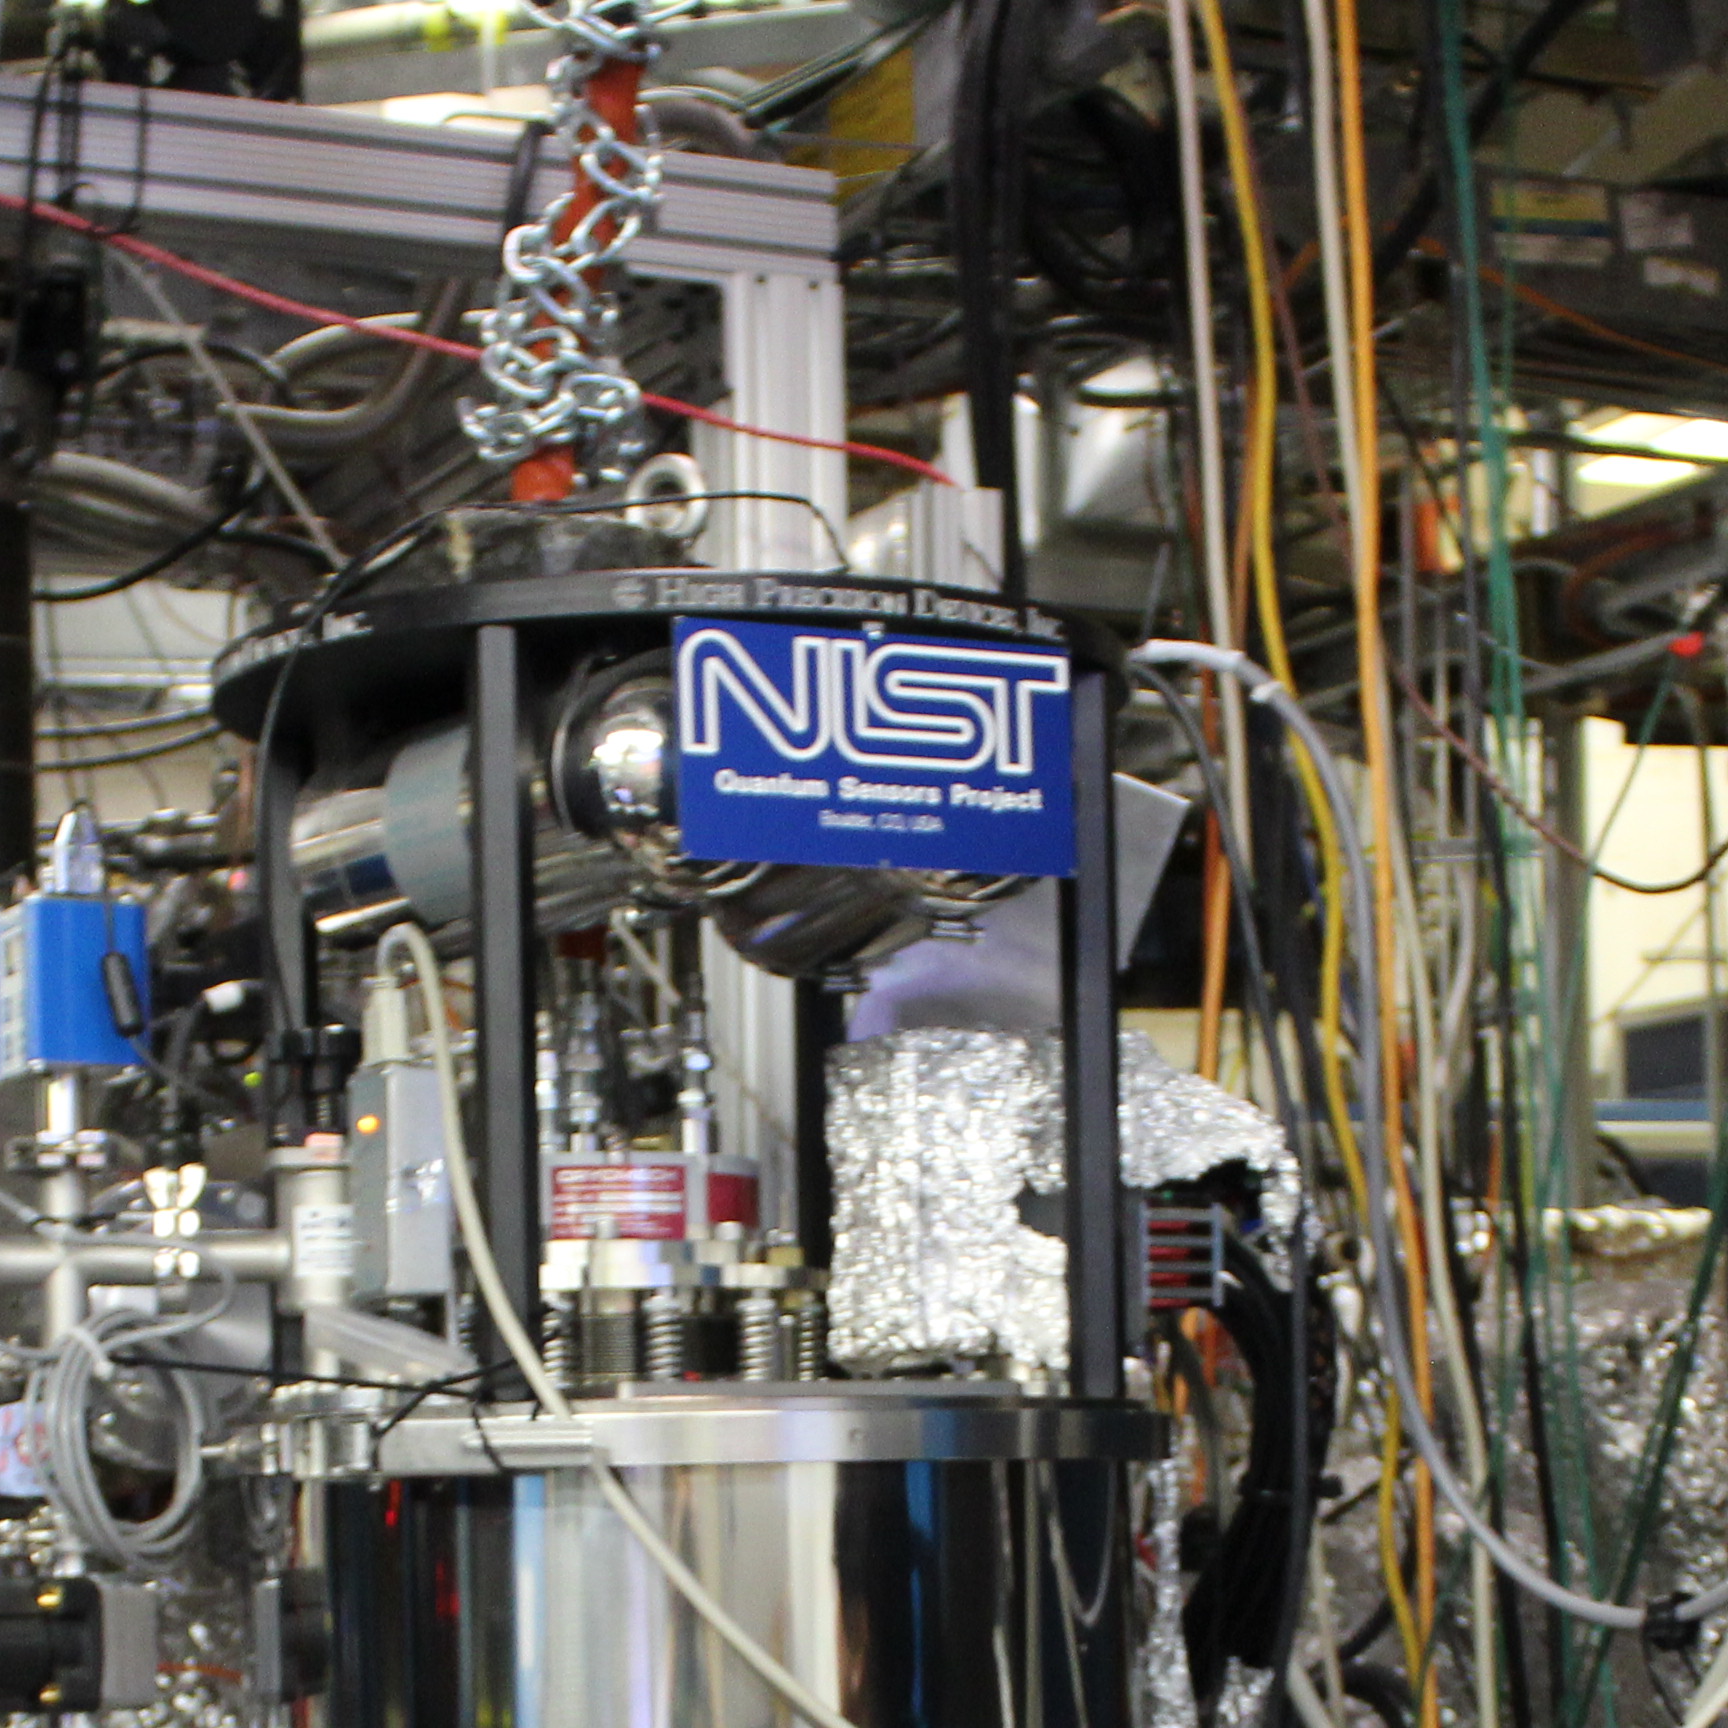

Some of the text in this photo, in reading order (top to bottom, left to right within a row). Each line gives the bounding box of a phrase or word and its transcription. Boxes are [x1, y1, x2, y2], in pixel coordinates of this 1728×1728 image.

[678, 628, 1070, 777] NIST
[713, 768, 1044, 813] Quantum Sensors Project
